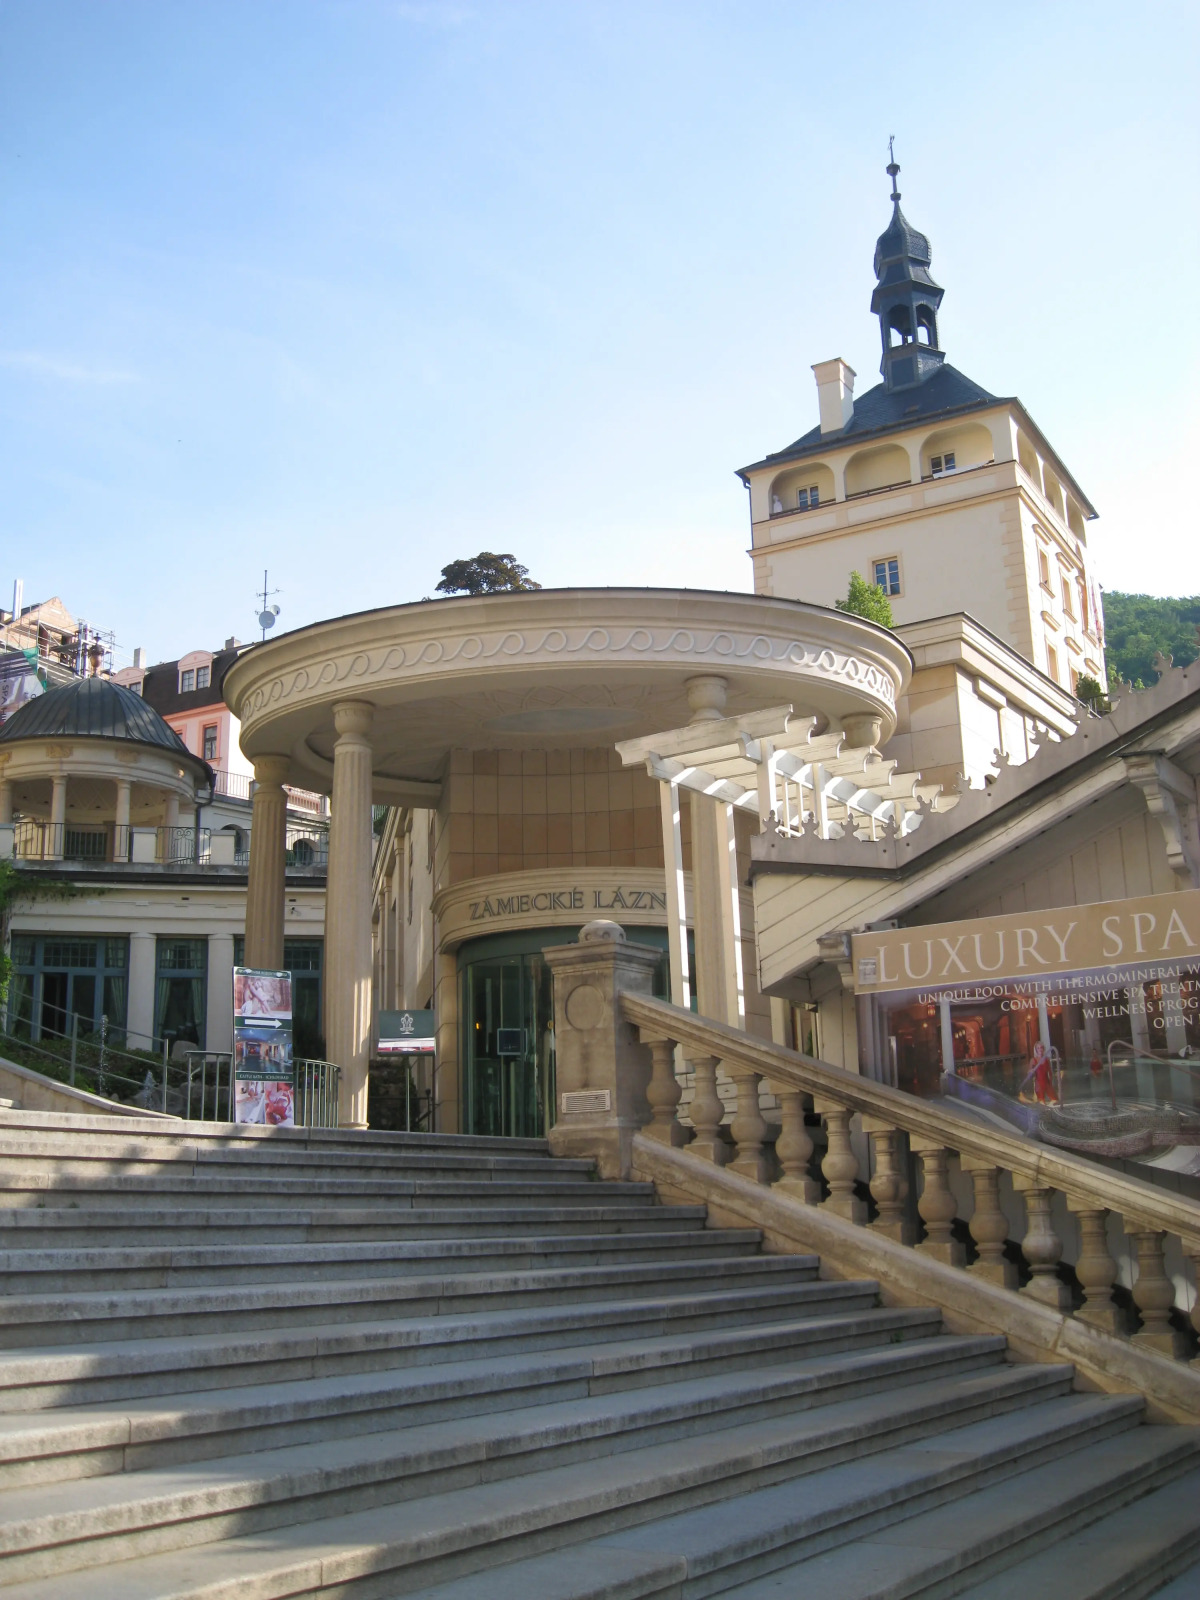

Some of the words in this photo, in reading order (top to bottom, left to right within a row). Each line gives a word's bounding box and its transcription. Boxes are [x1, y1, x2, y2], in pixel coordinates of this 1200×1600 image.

[469, 886, 584, 920] ZÁMECKÉ
[593, 886, 667, 910] LÁZN
[876, 922, 1078, 983] LUXURY
[1101, 908, 1198, 957] SPA
[918, 988, 970, 1004] UNIQUE
[975, 984, 1011, 999] POOL
[1014, 980, 1052, 994] WITH
[1056, 965, 1183, 989] THERMOMINERAL
[1001, 989, 1119, 1012] COMPREHENSIVE
[1123, 983, 1147, 999] SPA
[1082, 1001, 1153, 1020] WELLNESS
[1158, 997, 1198, 1012] PROG
[1153, 1015, 1193, 1029] OPEN
